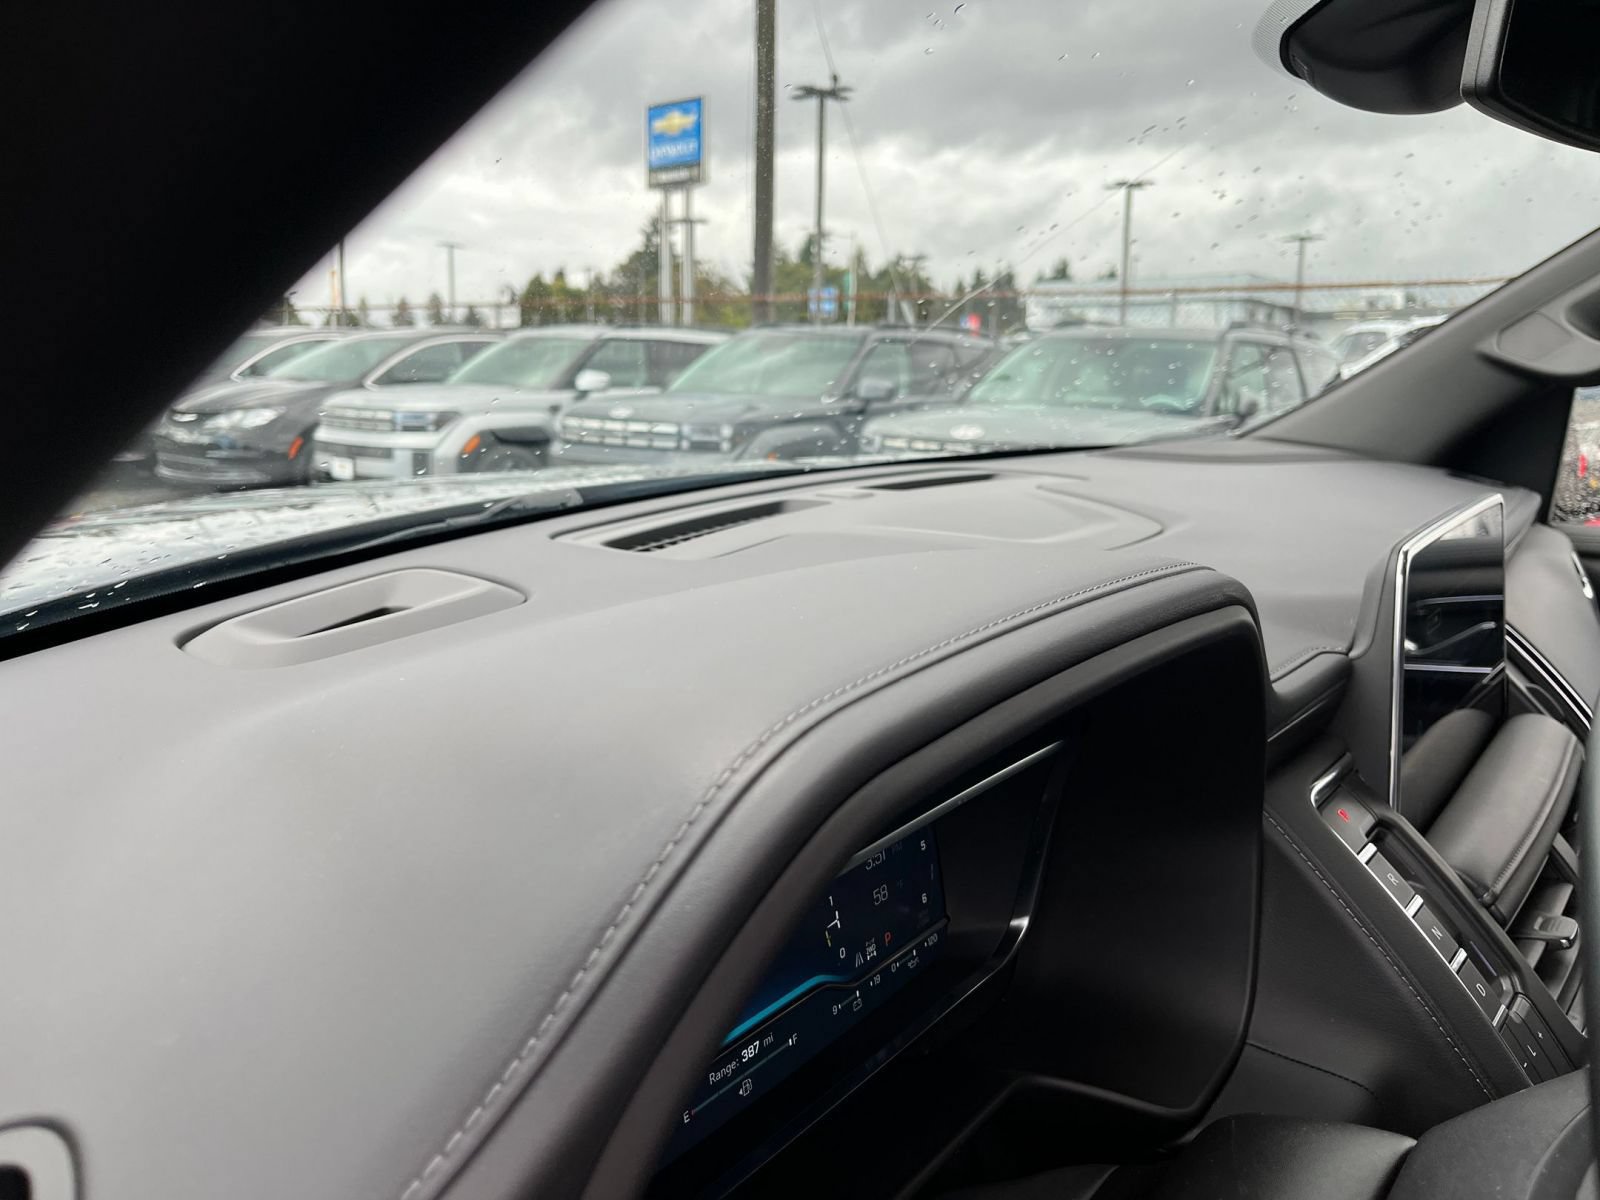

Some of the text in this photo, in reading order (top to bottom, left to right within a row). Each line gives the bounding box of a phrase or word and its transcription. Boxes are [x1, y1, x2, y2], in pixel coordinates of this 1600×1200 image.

[920, 840, 927, 851] 5
[1387, 873, 1399, 885] R
[872, 884, 889, 906] 58
[921, 893, 928, 904] 6
[884, 931, 892, 946] P
[839, 947, 846, 959] 0
[1476, 983, 1486, 997] D
[832, 1004, 838, 1015] 9
[792, 1033, 799, 1045] F
[709, 1032, 774, 1085] Range: 387 mi
[683, 1110, 691, 1124] E
